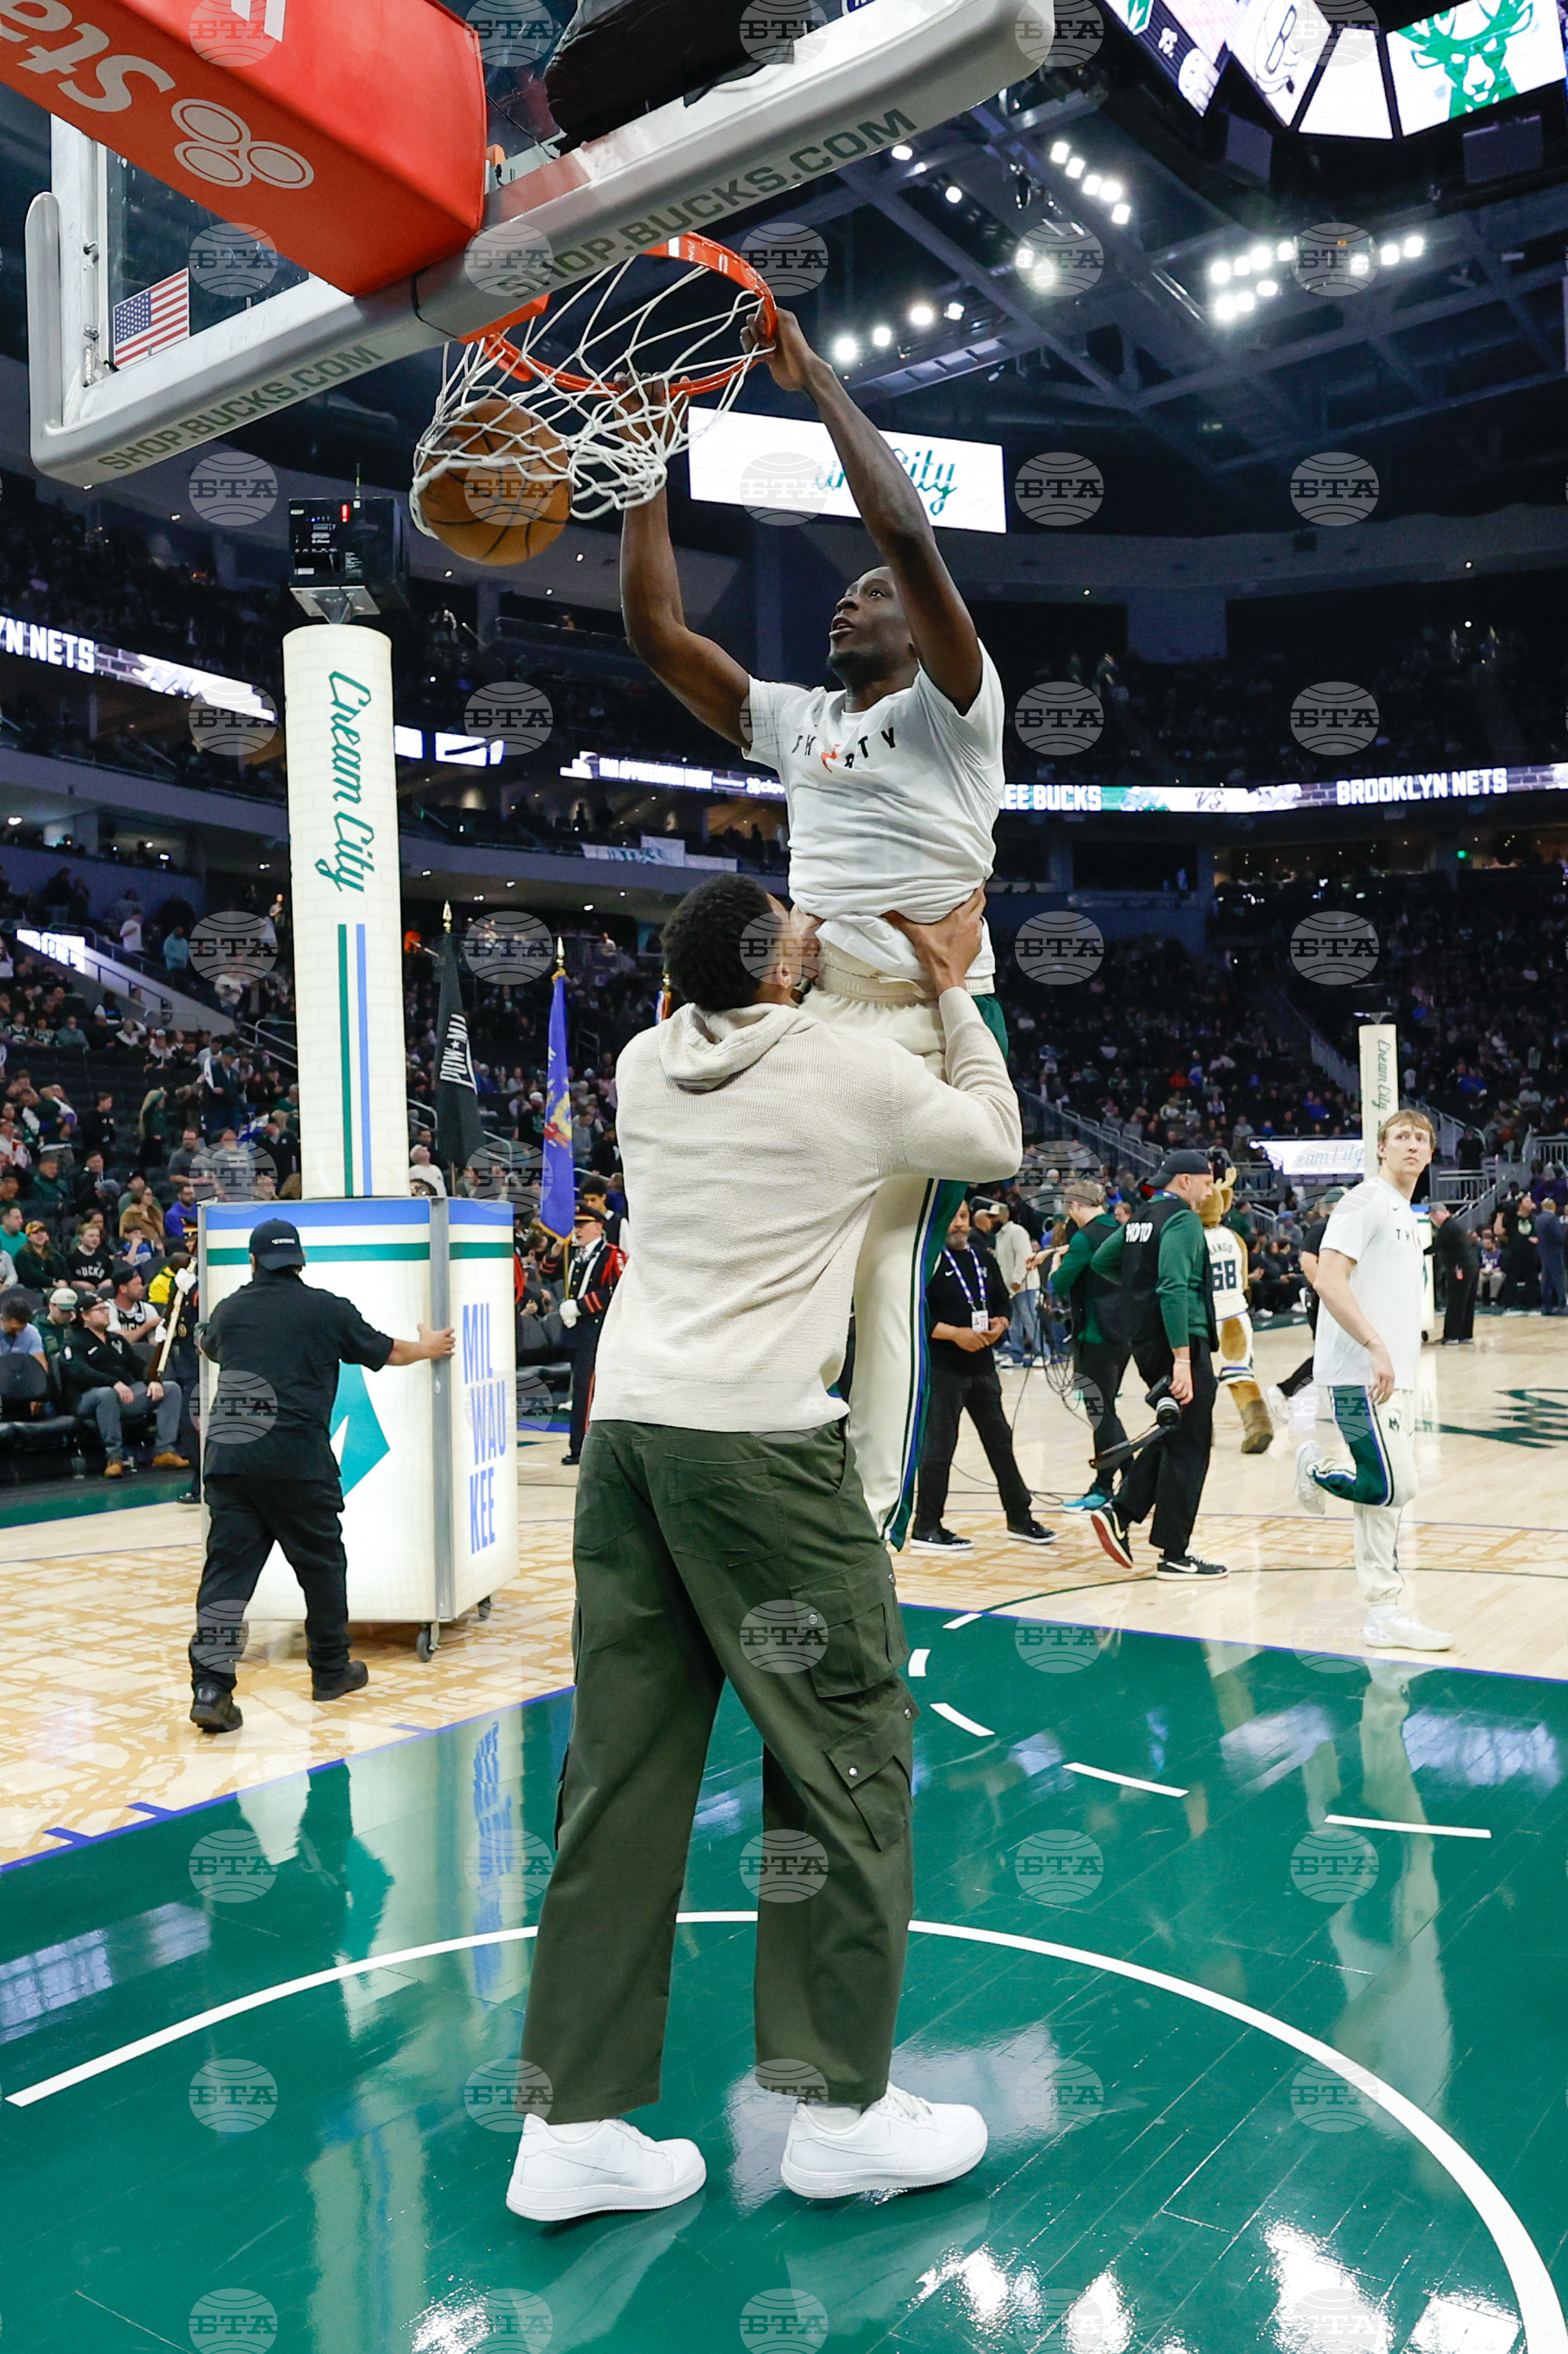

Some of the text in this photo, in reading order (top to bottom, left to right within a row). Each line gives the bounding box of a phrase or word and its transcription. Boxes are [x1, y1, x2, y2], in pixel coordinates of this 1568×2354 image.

[497, 108, 918, 298] SHOP.BUCKS.COM
[97, 345, 384, 470] SHOP.BUCKS.COM
[30, 624, 96, 675] NETS
[314, 670, 375, 893] Cream City
[999, 783, 1102, 811] EE BUCKS
[1336, 767, 1508, 806] BROOKLYN NETS
[1377, 1039, 1391, 1082] Cream
[1125, 1222, 1153, 1242] HOTO
[1209, 1242, 1233, 1256] ANGO
[1212, 1259, 1237, 1291] 68
[463, 1303, 493, 1384] MIL
[471, 1380, 506, 1466] WAU
[470, 1466, 495, 1555] KEE
